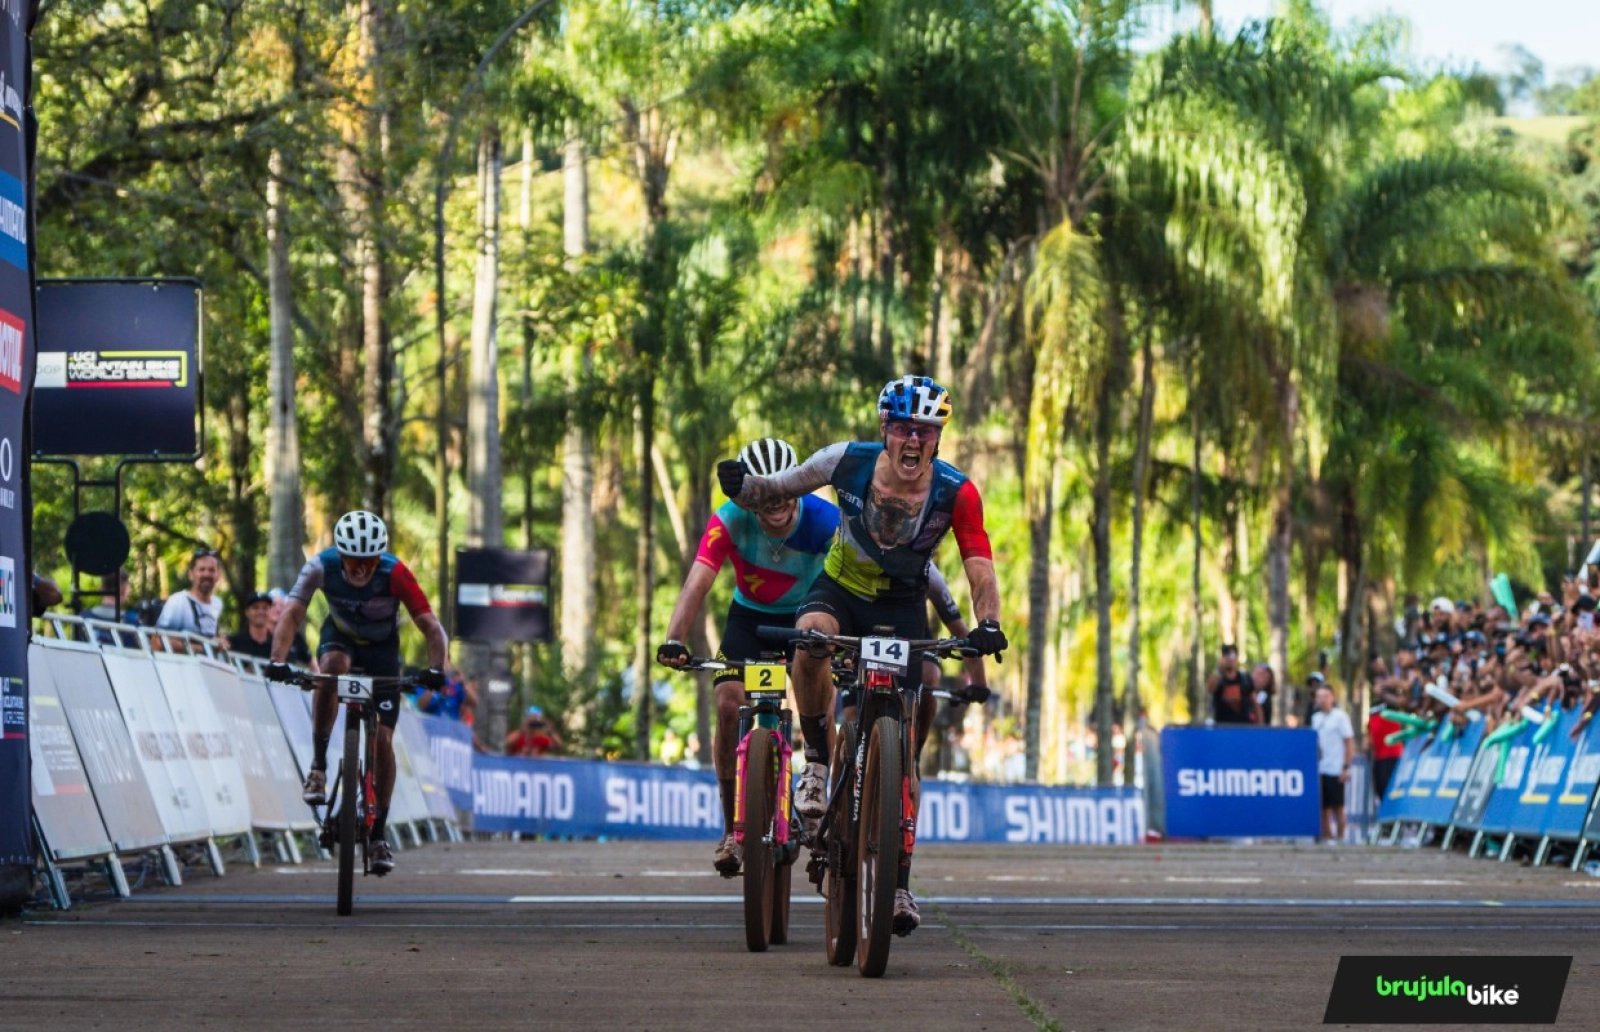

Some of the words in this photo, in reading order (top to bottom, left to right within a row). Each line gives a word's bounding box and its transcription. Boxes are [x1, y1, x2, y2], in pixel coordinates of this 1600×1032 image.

[73, 351, 97, 361] UCI
[68, 360, 144, 370] MOUNTAIN
[145, 360, 180, 370] BIKE
[68, 369, 124, 380] WORLD
[126, 369, 180, 380] SERIES
[869, 640, 903, 660] 14
[759, 668, 772, 687] 2
[348, 680, 361, 695] 8
[1177, 768, 1304, 797] SHIMANO
